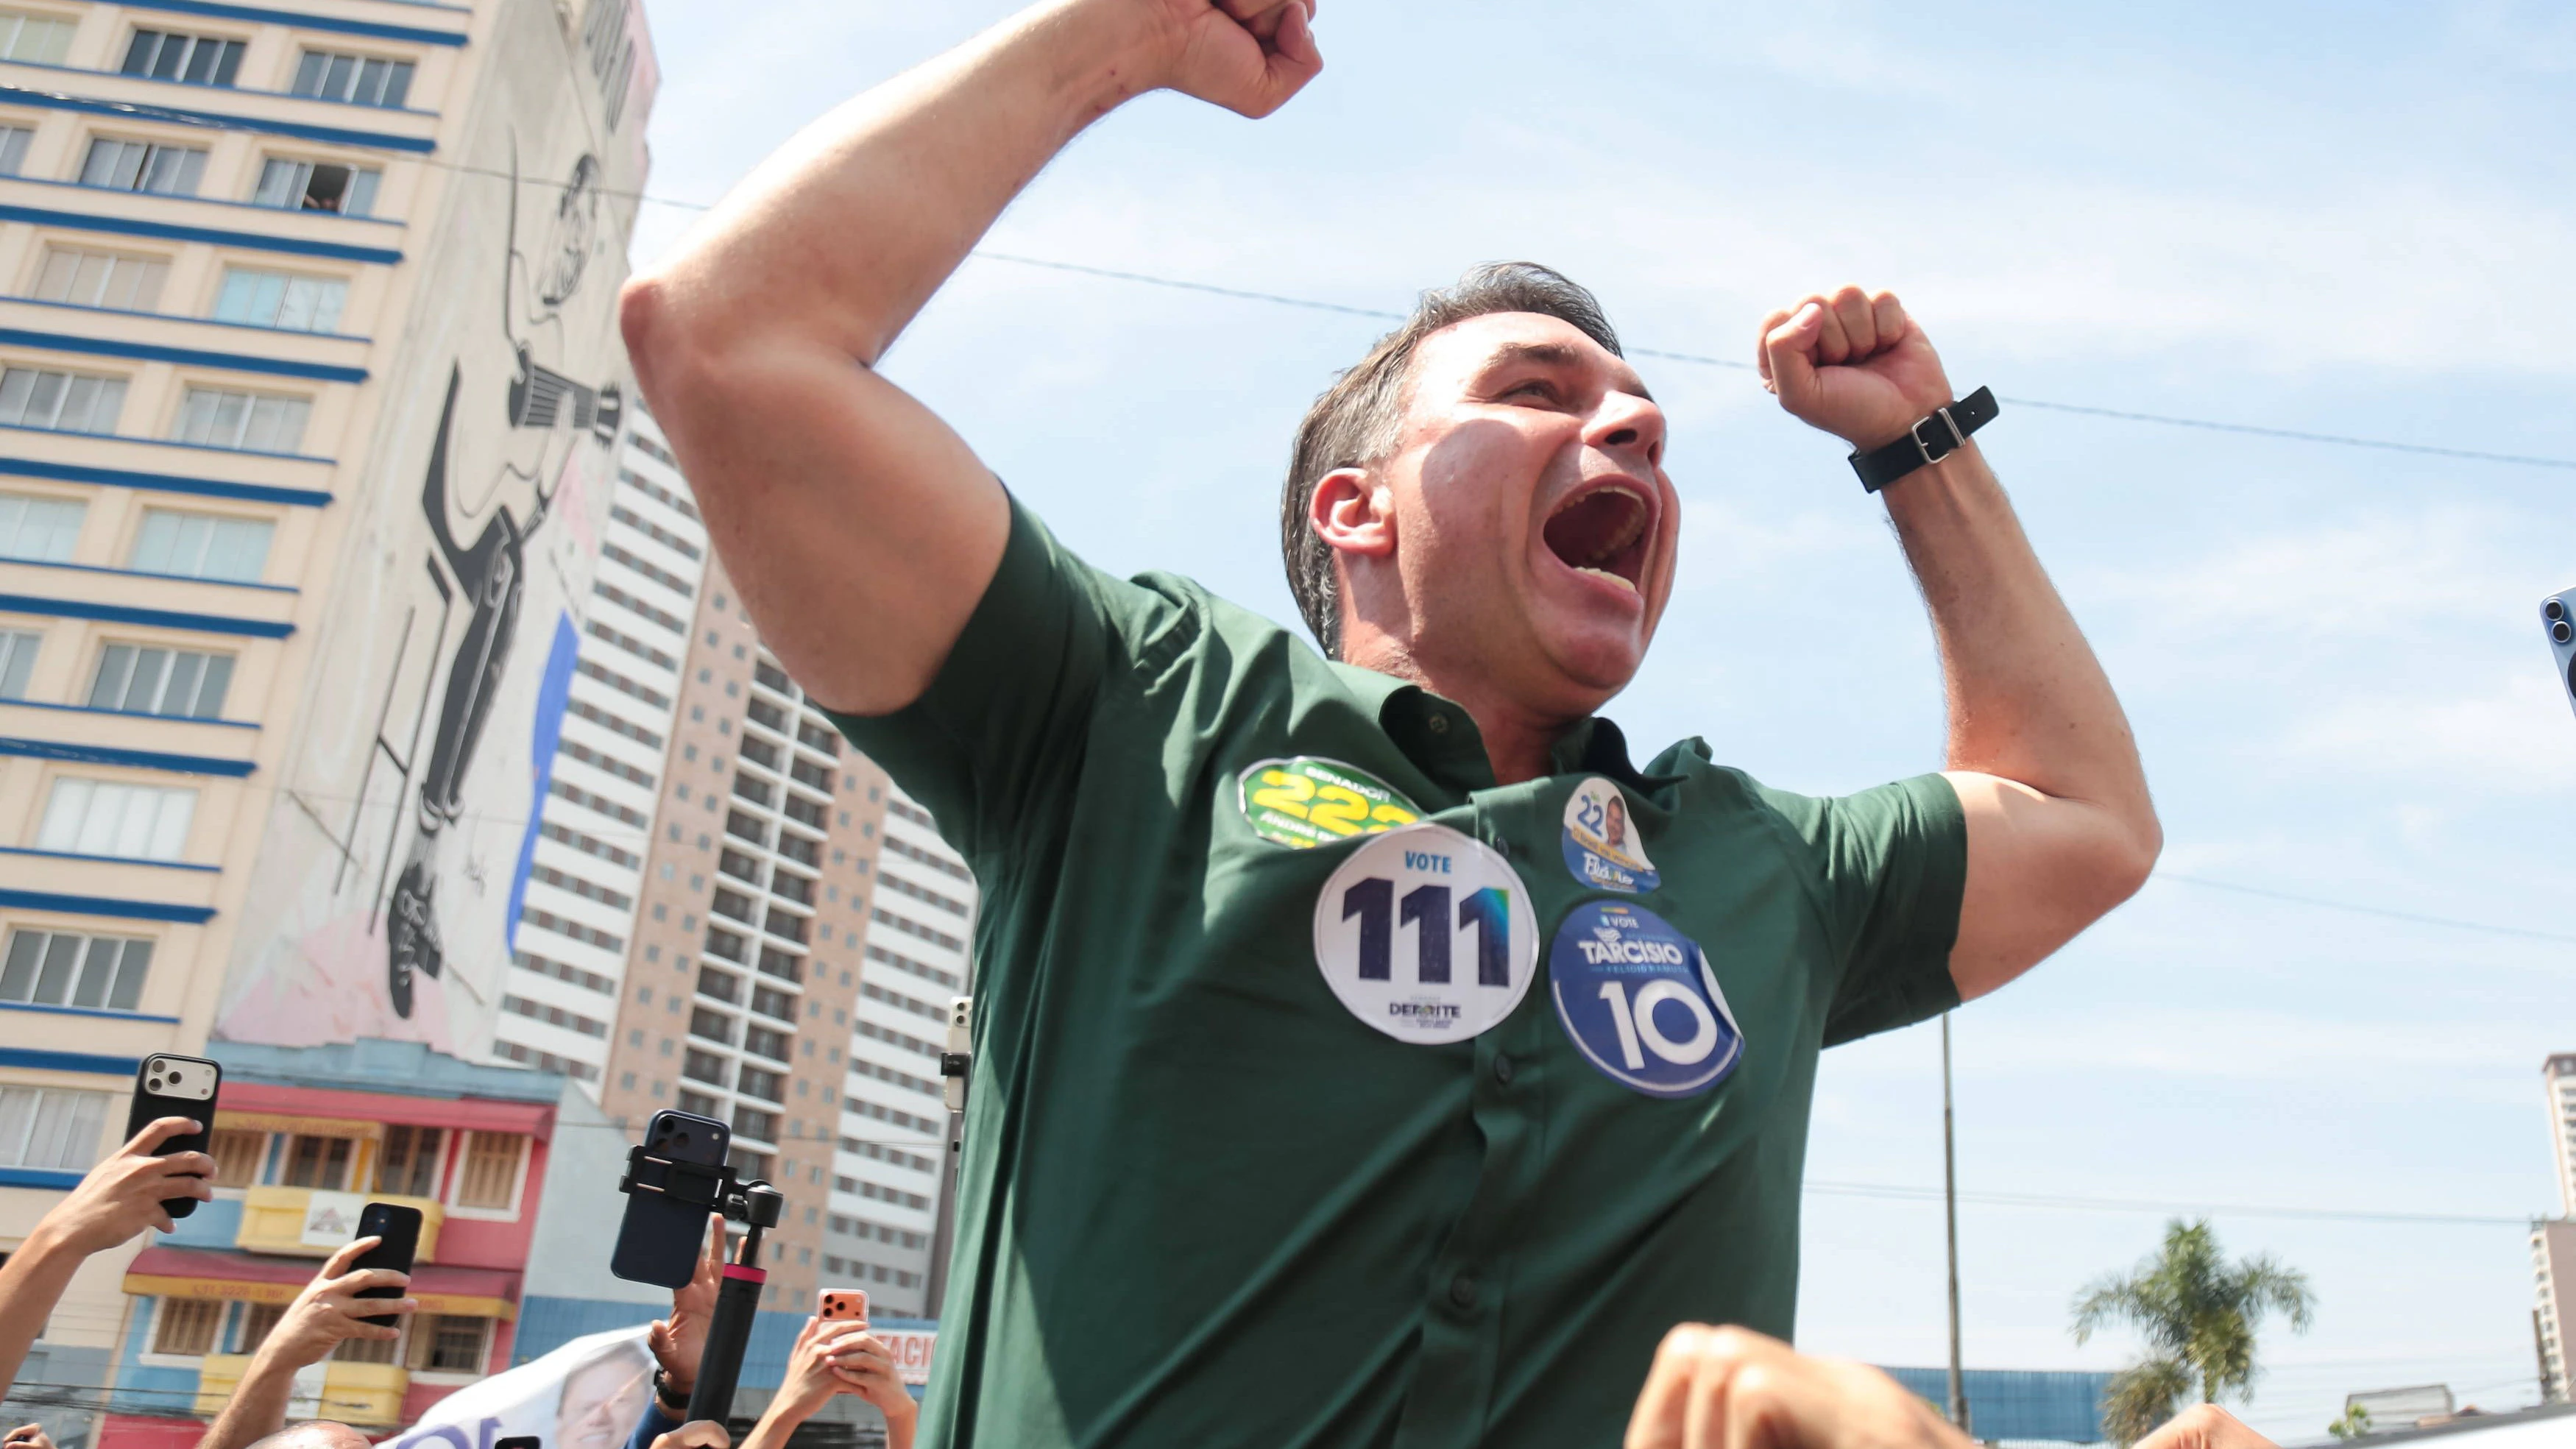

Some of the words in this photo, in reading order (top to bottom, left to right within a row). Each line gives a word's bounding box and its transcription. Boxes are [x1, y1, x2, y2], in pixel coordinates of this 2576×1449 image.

[1304, 766, 1391, 802] SENADOR
[1577, 795, 1604, 837] 22
[1405, 851, 1451, 874] VOTE
[1342, 877, 1510, 988] 111
[1610, 915, 1640, 929] VOTE
[1577, 938, 1683, 965] TARCÍSIO
[1599, 979, 1718, 1070] 10
